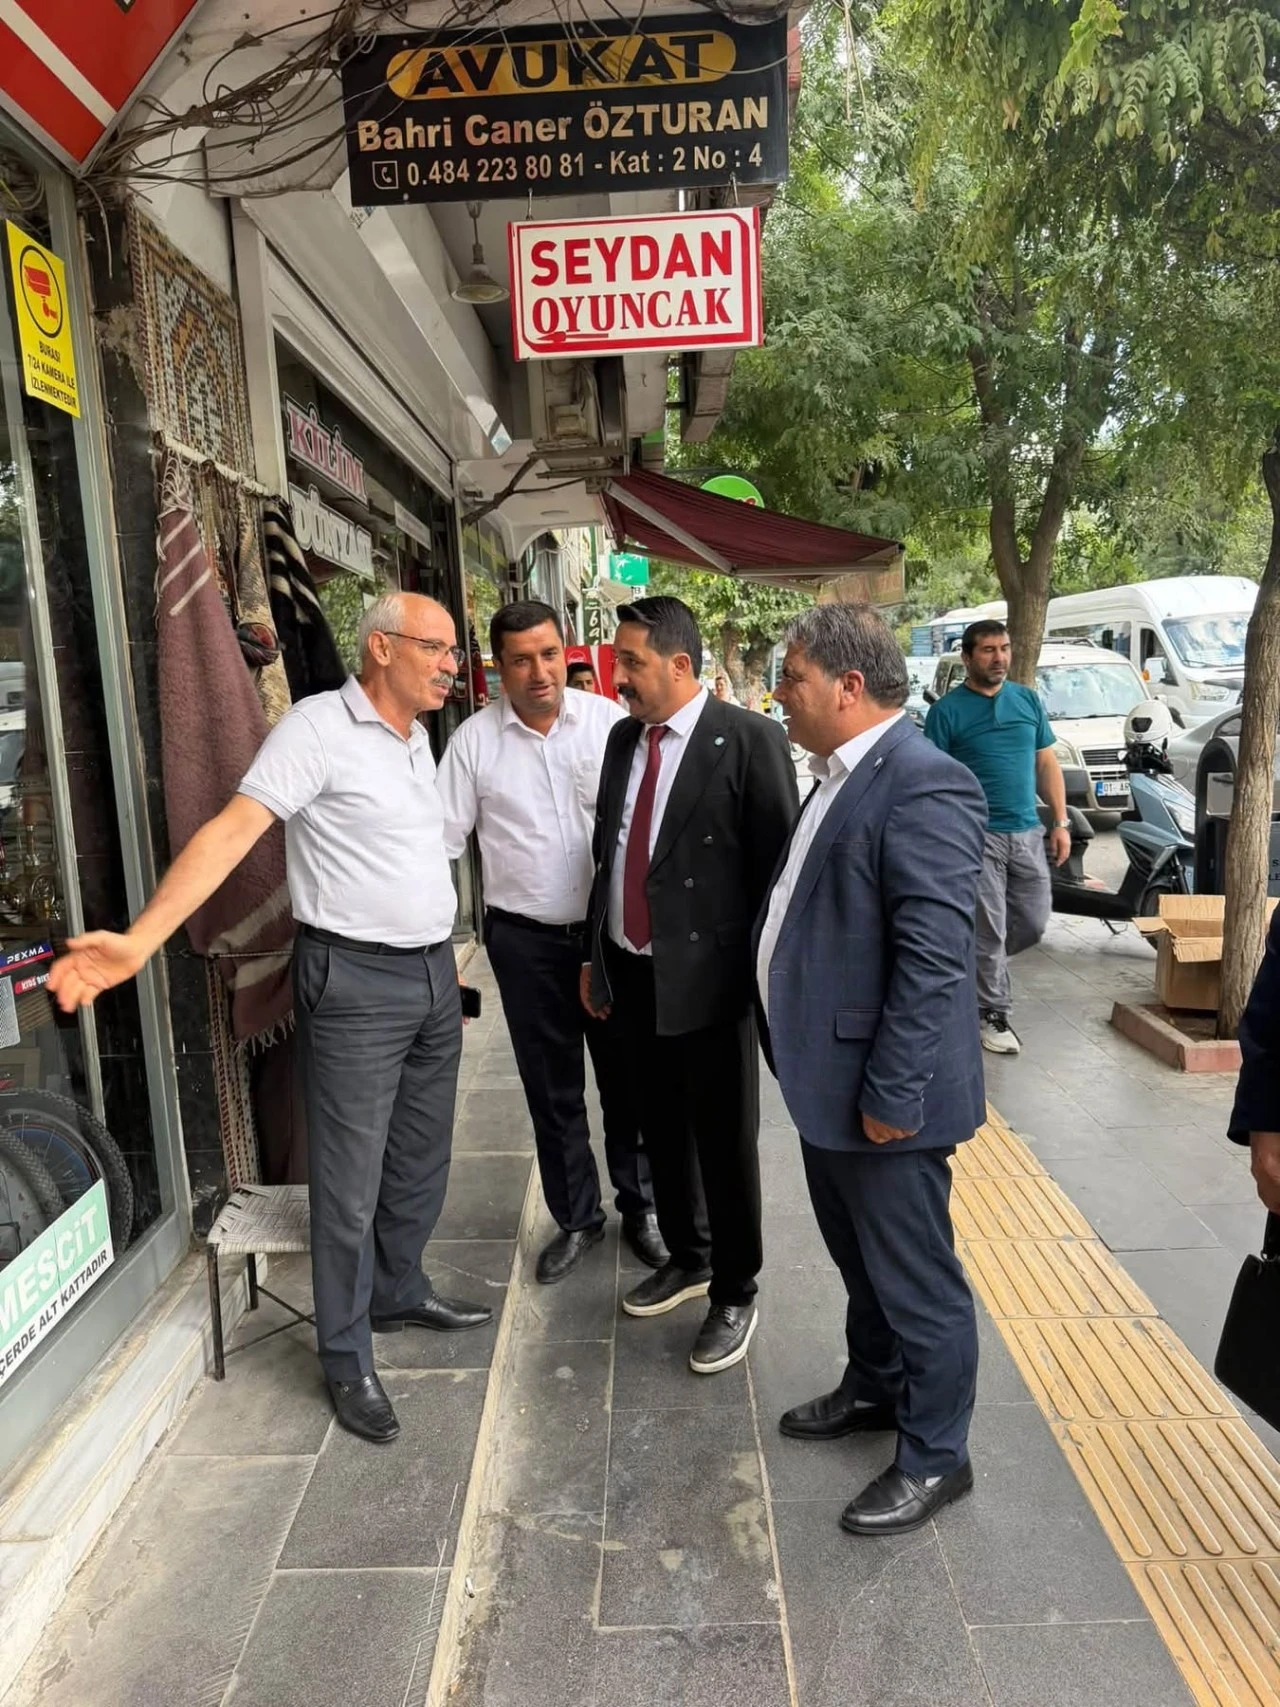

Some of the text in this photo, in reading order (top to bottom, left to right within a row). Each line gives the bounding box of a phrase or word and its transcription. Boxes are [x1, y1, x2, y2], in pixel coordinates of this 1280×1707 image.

[412, 34, 713, 94] AVUKAT
[357, 97, 768, 152] Bahri Caner ÖZTURAN
[407, 161, 470, 187] 0.484
[477, 157, 518, 183] 223
[525, 154, 552, 179] 80
[559, 152, 584, 177] 81
[610, 150, 650, 175] Kat
[673, 147, 685, 171] 2
[694, 145, 726, 169] No
[748, 143, 762, 167] 4
[530, 229, 733, 287] SEYDAN
[531, 287, 733, 334] OYUNCAK
[39, 340, 61, 363] BURASI
[41, 360, 65, 383] KAMERA
[287, 401, 368, 504] KİLİM
[7, 945, 45, 965] PEXMA
[22, 976, 37, 990] KIDS
[39, 1301, 58, 1333] ALT
[60, 1250, 108, 1309] KATTADIR
